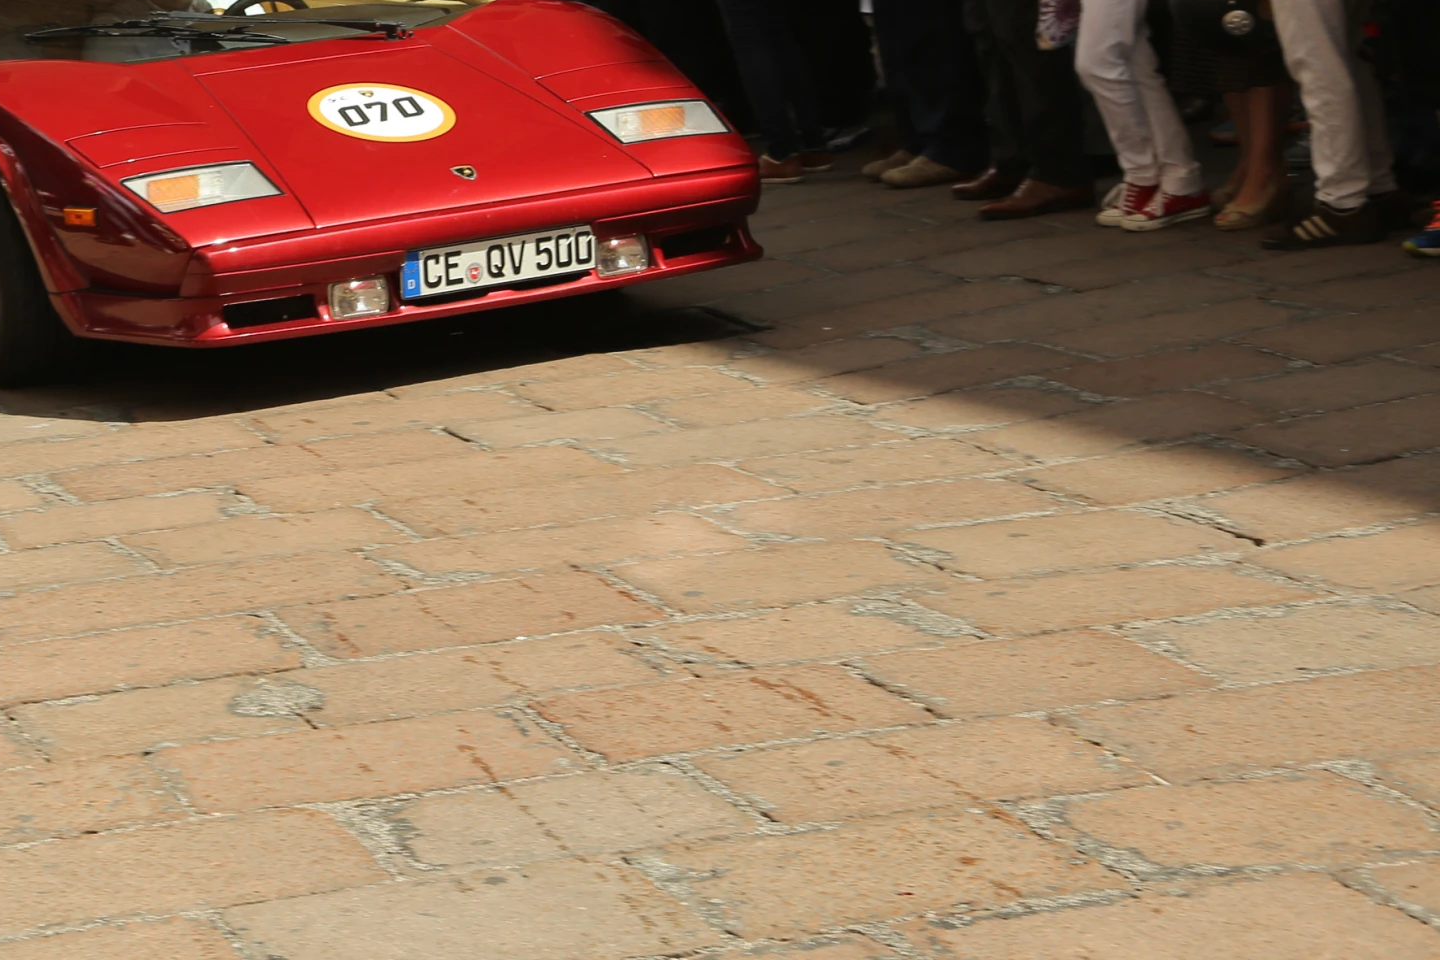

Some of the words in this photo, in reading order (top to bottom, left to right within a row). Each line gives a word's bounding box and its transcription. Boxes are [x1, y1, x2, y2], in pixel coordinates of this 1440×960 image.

[337, 96, 425, 127] 070
[423, 250, 464, 289] CE
[486, 240, 526, 279] QV
[535, 230, 593, 271] 500
[407, 279, 417, 290] D
